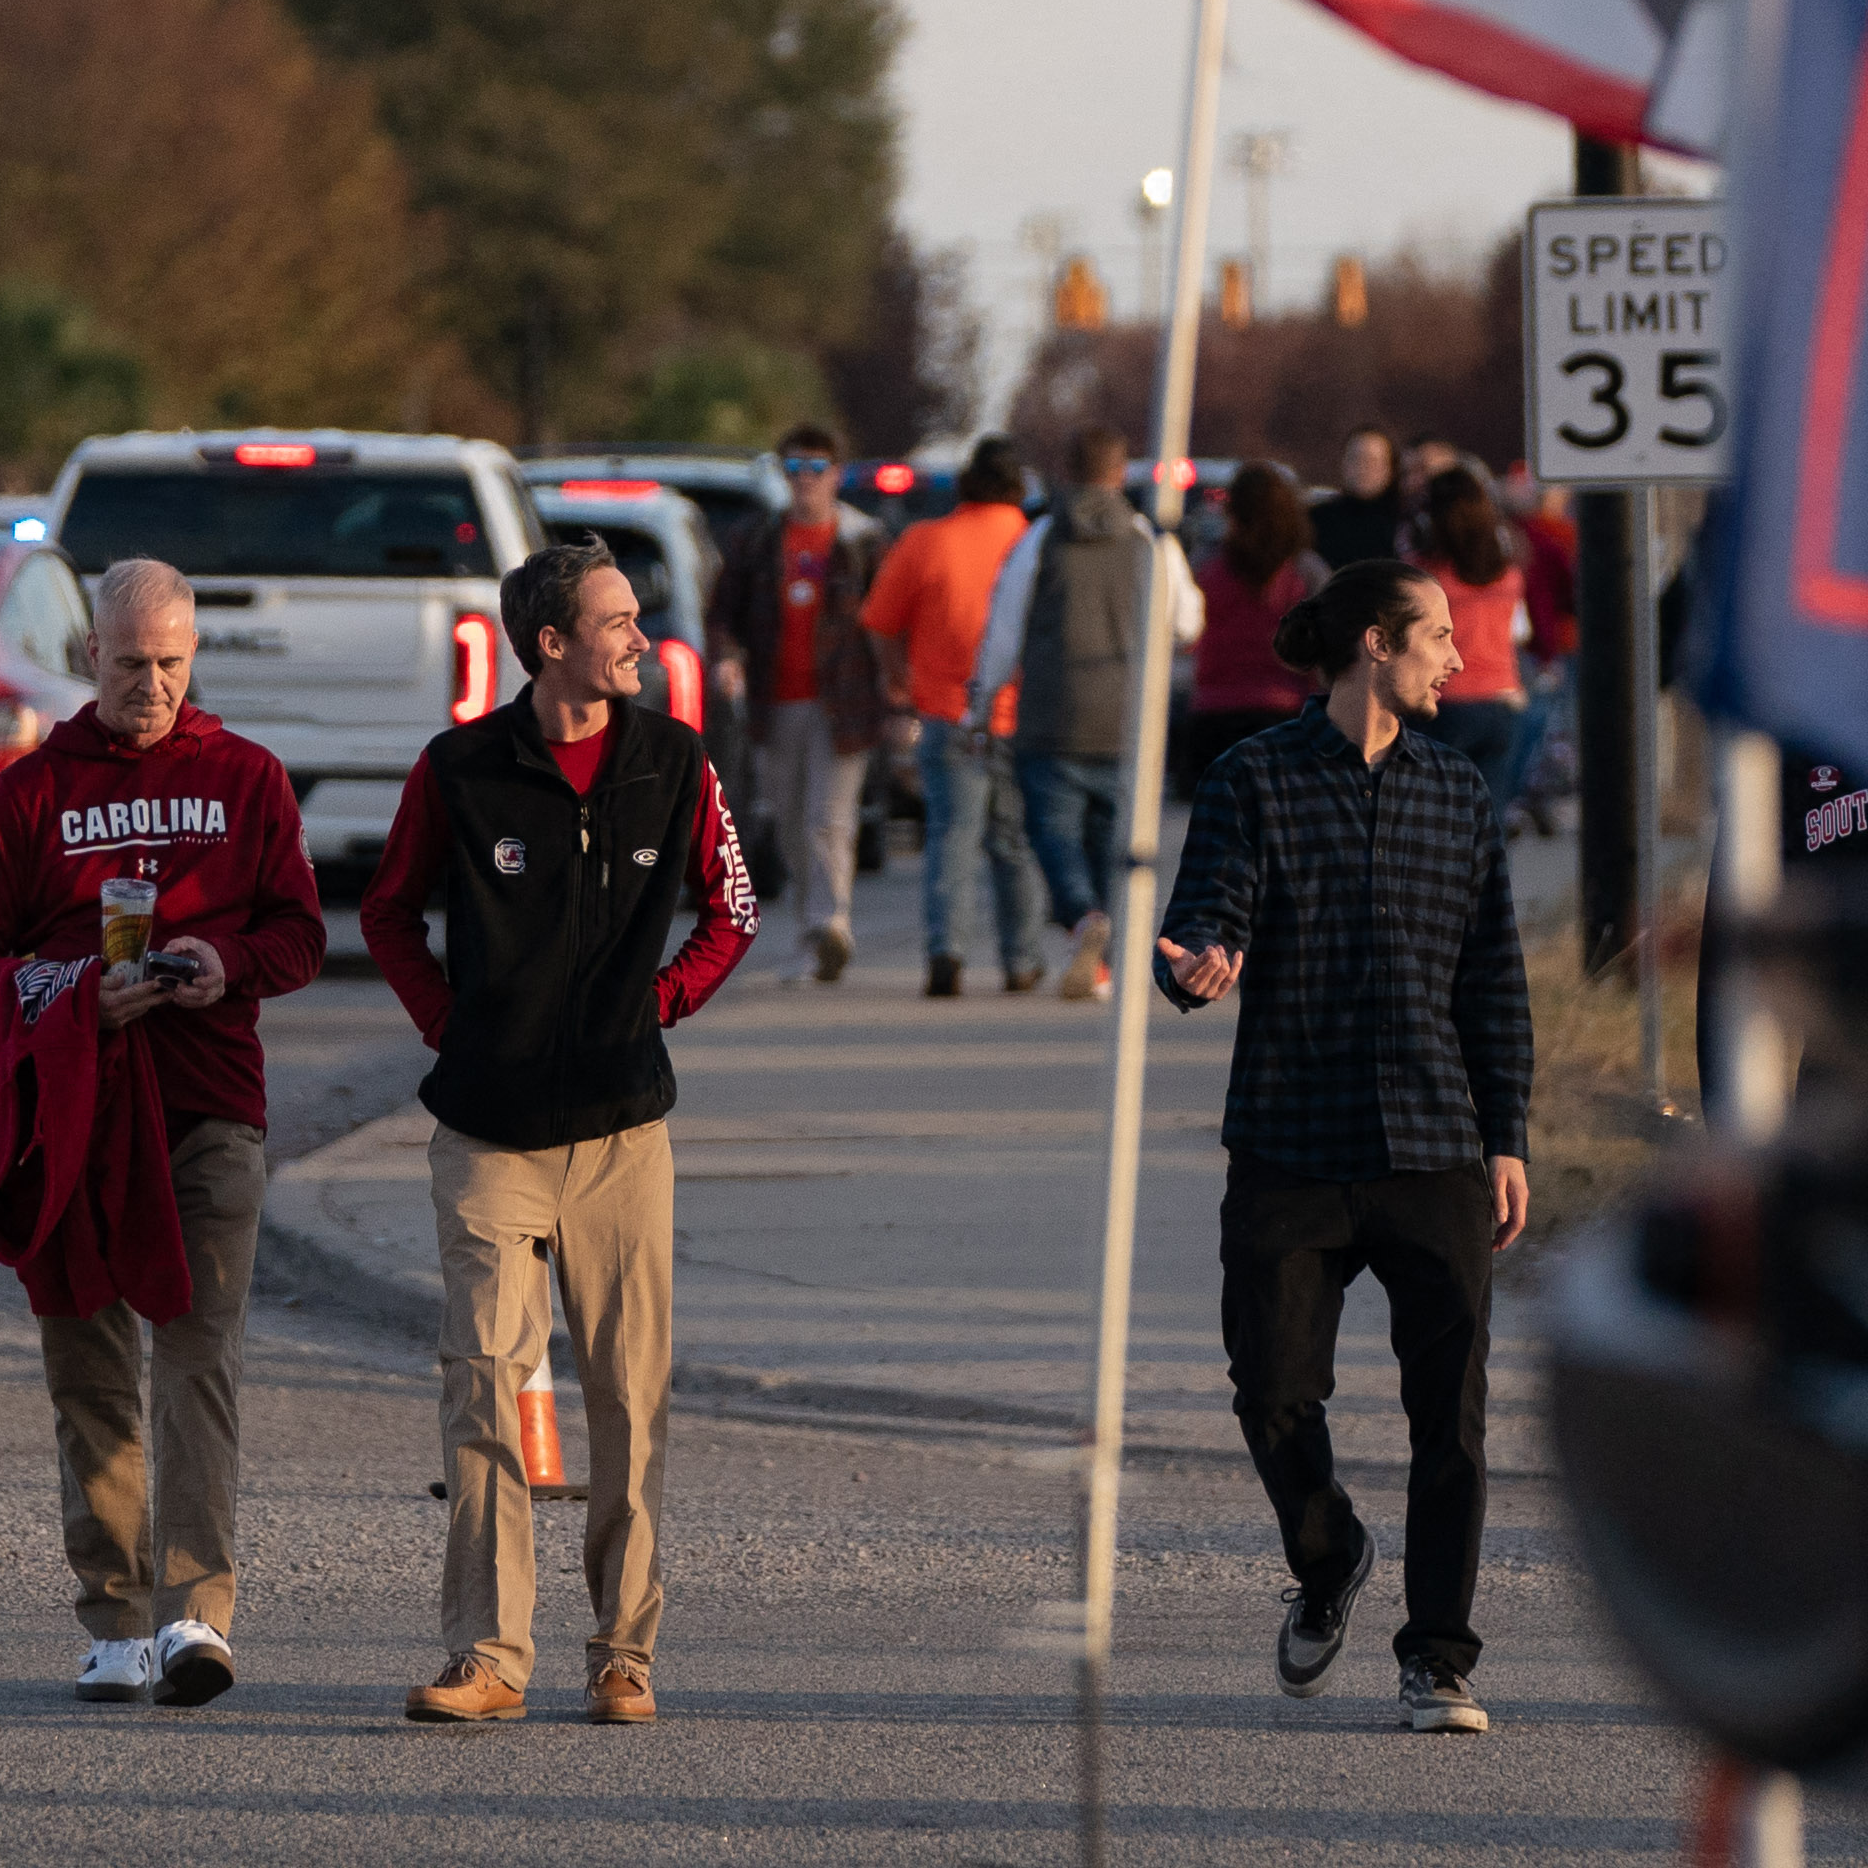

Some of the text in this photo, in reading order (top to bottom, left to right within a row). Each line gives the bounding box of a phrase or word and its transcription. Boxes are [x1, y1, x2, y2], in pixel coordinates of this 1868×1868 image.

[1548, 235, 1726, 277] SPEED
[1569, 292, 1709, 335] LIMIT
[1557, 351, 1727, 448] 35
[61, 798, 227, 844] CAROLINA
